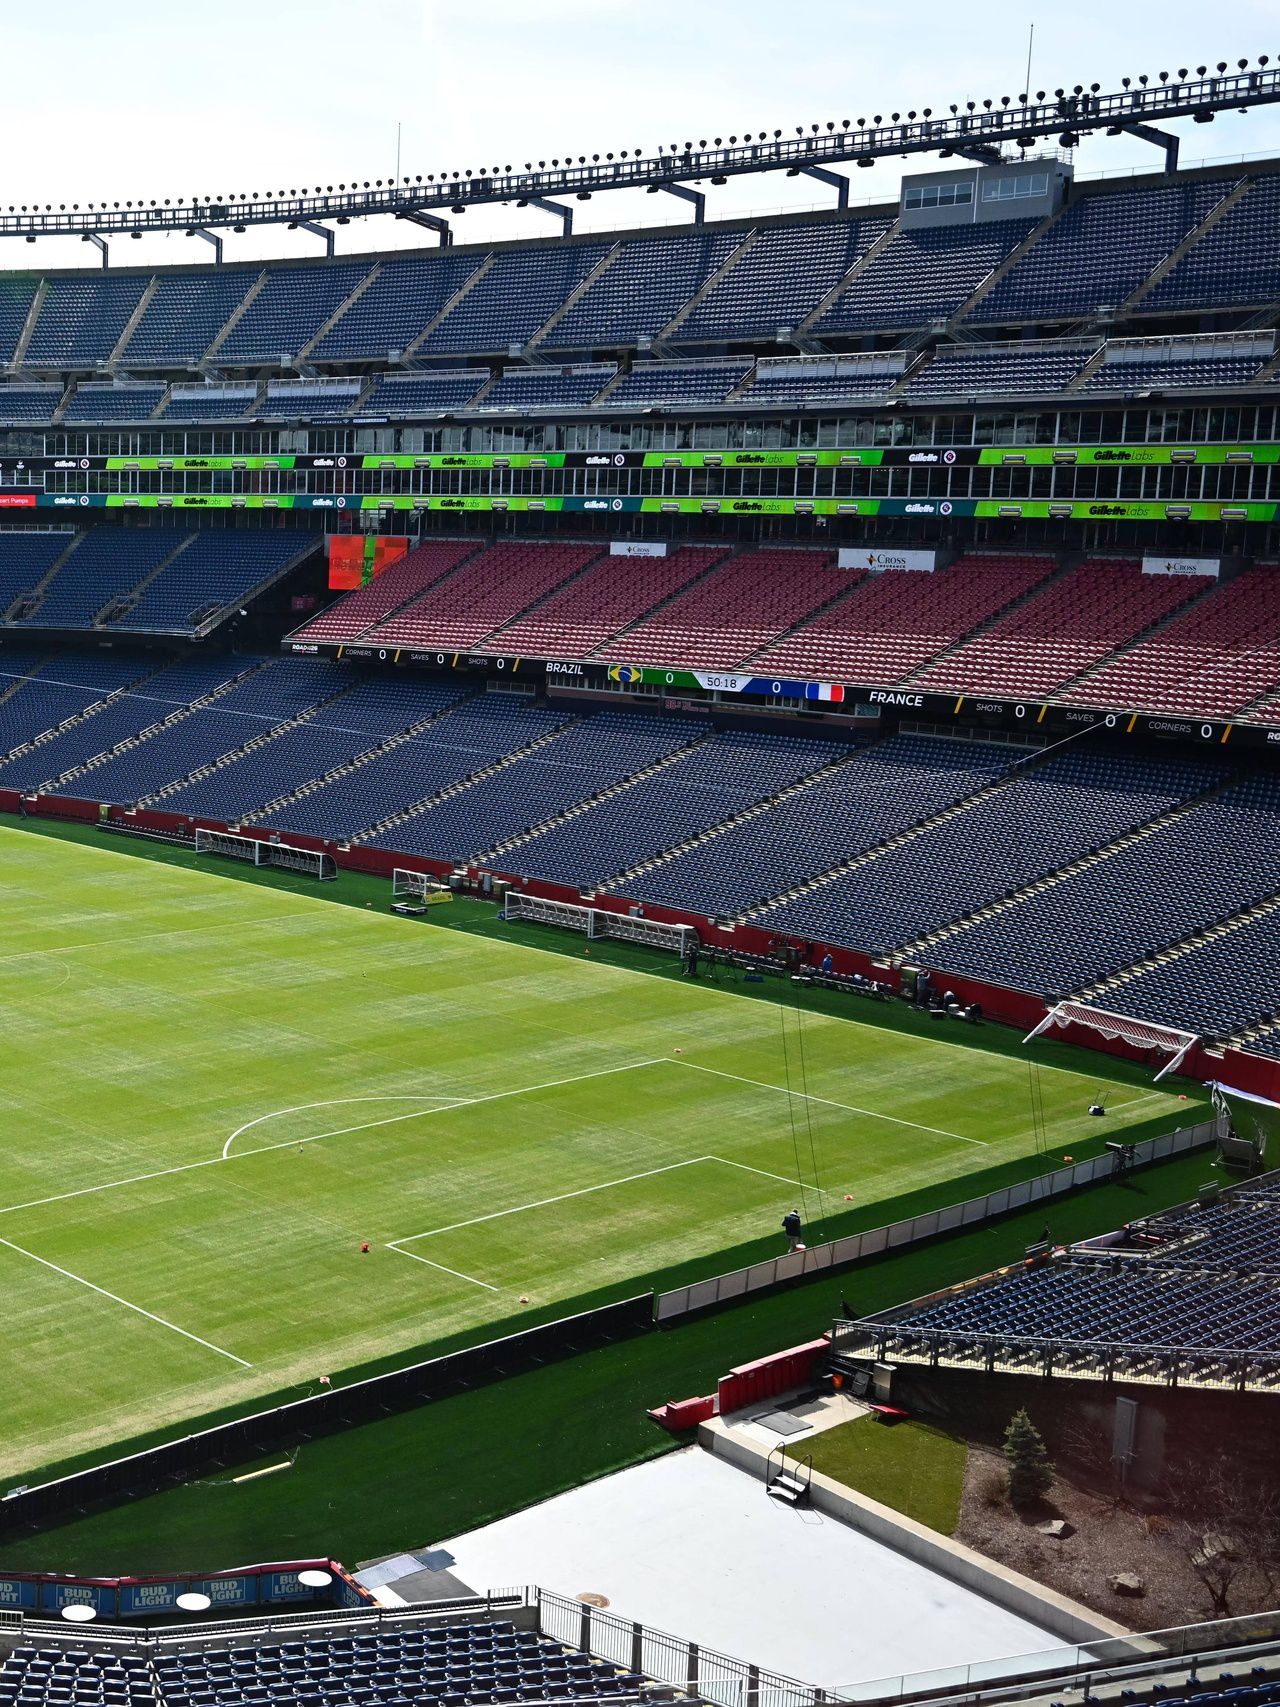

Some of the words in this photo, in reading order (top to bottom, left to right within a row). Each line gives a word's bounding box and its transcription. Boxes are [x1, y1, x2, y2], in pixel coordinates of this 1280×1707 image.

[586, 456, 610, 465] Gillette
[908, 453, 938, 462] Gillette
[905, 504, 934, 513] Gillette
[877, 554, 906, 564] CROSS
[1174, 562, 1197, 571] CROSS
[345, 648, 372, 656] CORNERS
[379, 650, 386, 660] 0
[410, 653, 429, 661] SAVES
[437, 654, 444, 664] 0
[468, 657, 488, 666] SHOTS
[496, 658, 505, 669] 0
[546, 662, 584, 675] BRAZIL
[666, 673, 674, 683] 0
[707, 677, 737, 688] 50:18
[772, 682, 781, 693] 0
[870, 691, 924, 706] FRANCE
[976, 703, 1003, 713] SHOTS
[1015, 705, 1025, 718] 0
[1066, 712, 1095, 723] SAVES
[1105, 714, 1116, 728] 0
[1148, 721, 1192, 733] CORNERS
[1201, 724, 1212, 738] 0
[140, 1586, 167, 1596] BUD
[210, 1581, 237, 1591] BUD
[64, 1588, 92, 1598] BUD
[135, 1595, 172, 1606] LIGHT
